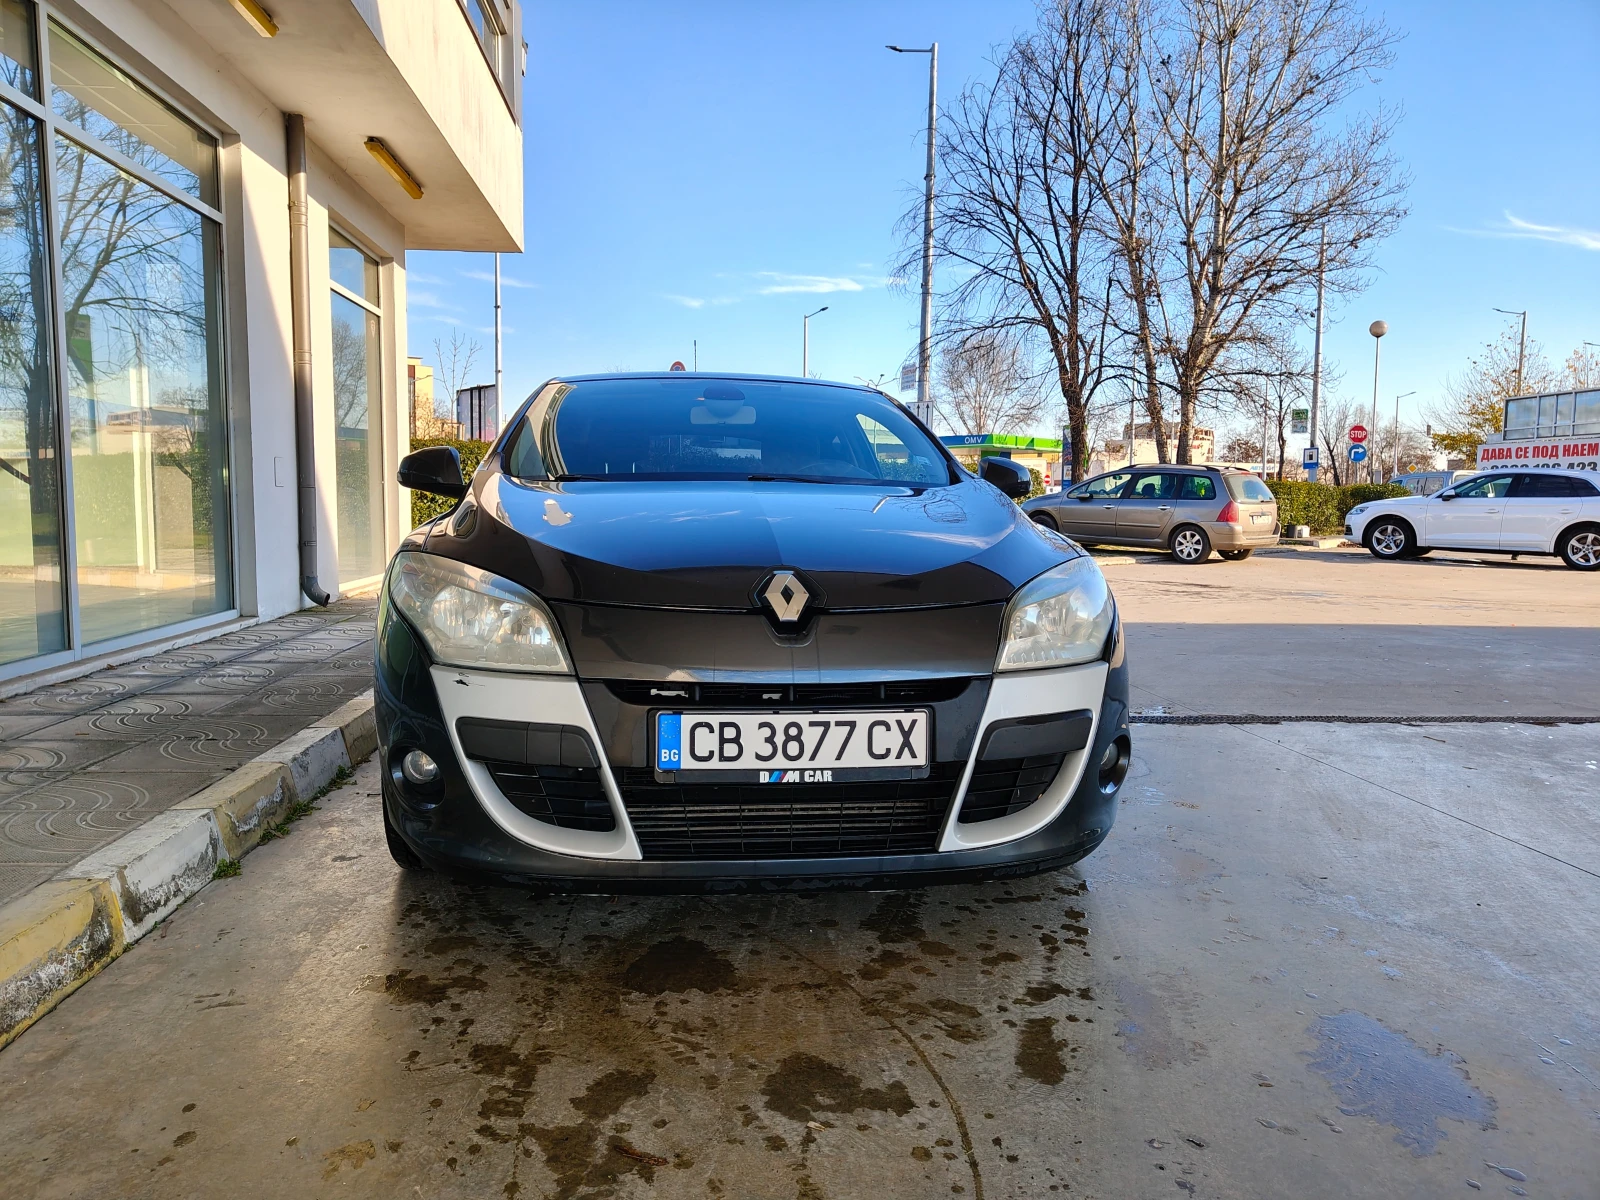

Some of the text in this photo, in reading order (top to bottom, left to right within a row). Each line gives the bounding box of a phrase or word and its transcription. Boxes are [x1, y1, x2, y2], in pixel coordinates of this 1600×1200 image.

[964, 436, 983, 444] OMV
[1350, 430, 1367, 439] STOP
[1481, 442, 1600, 462] ДАВА СЕ ПОД НАЕМ
[689, 719, 919, 762] CB 3877 CX
[661, 749, 679, 762] BG
[804, 770, 833, 782] CAR
